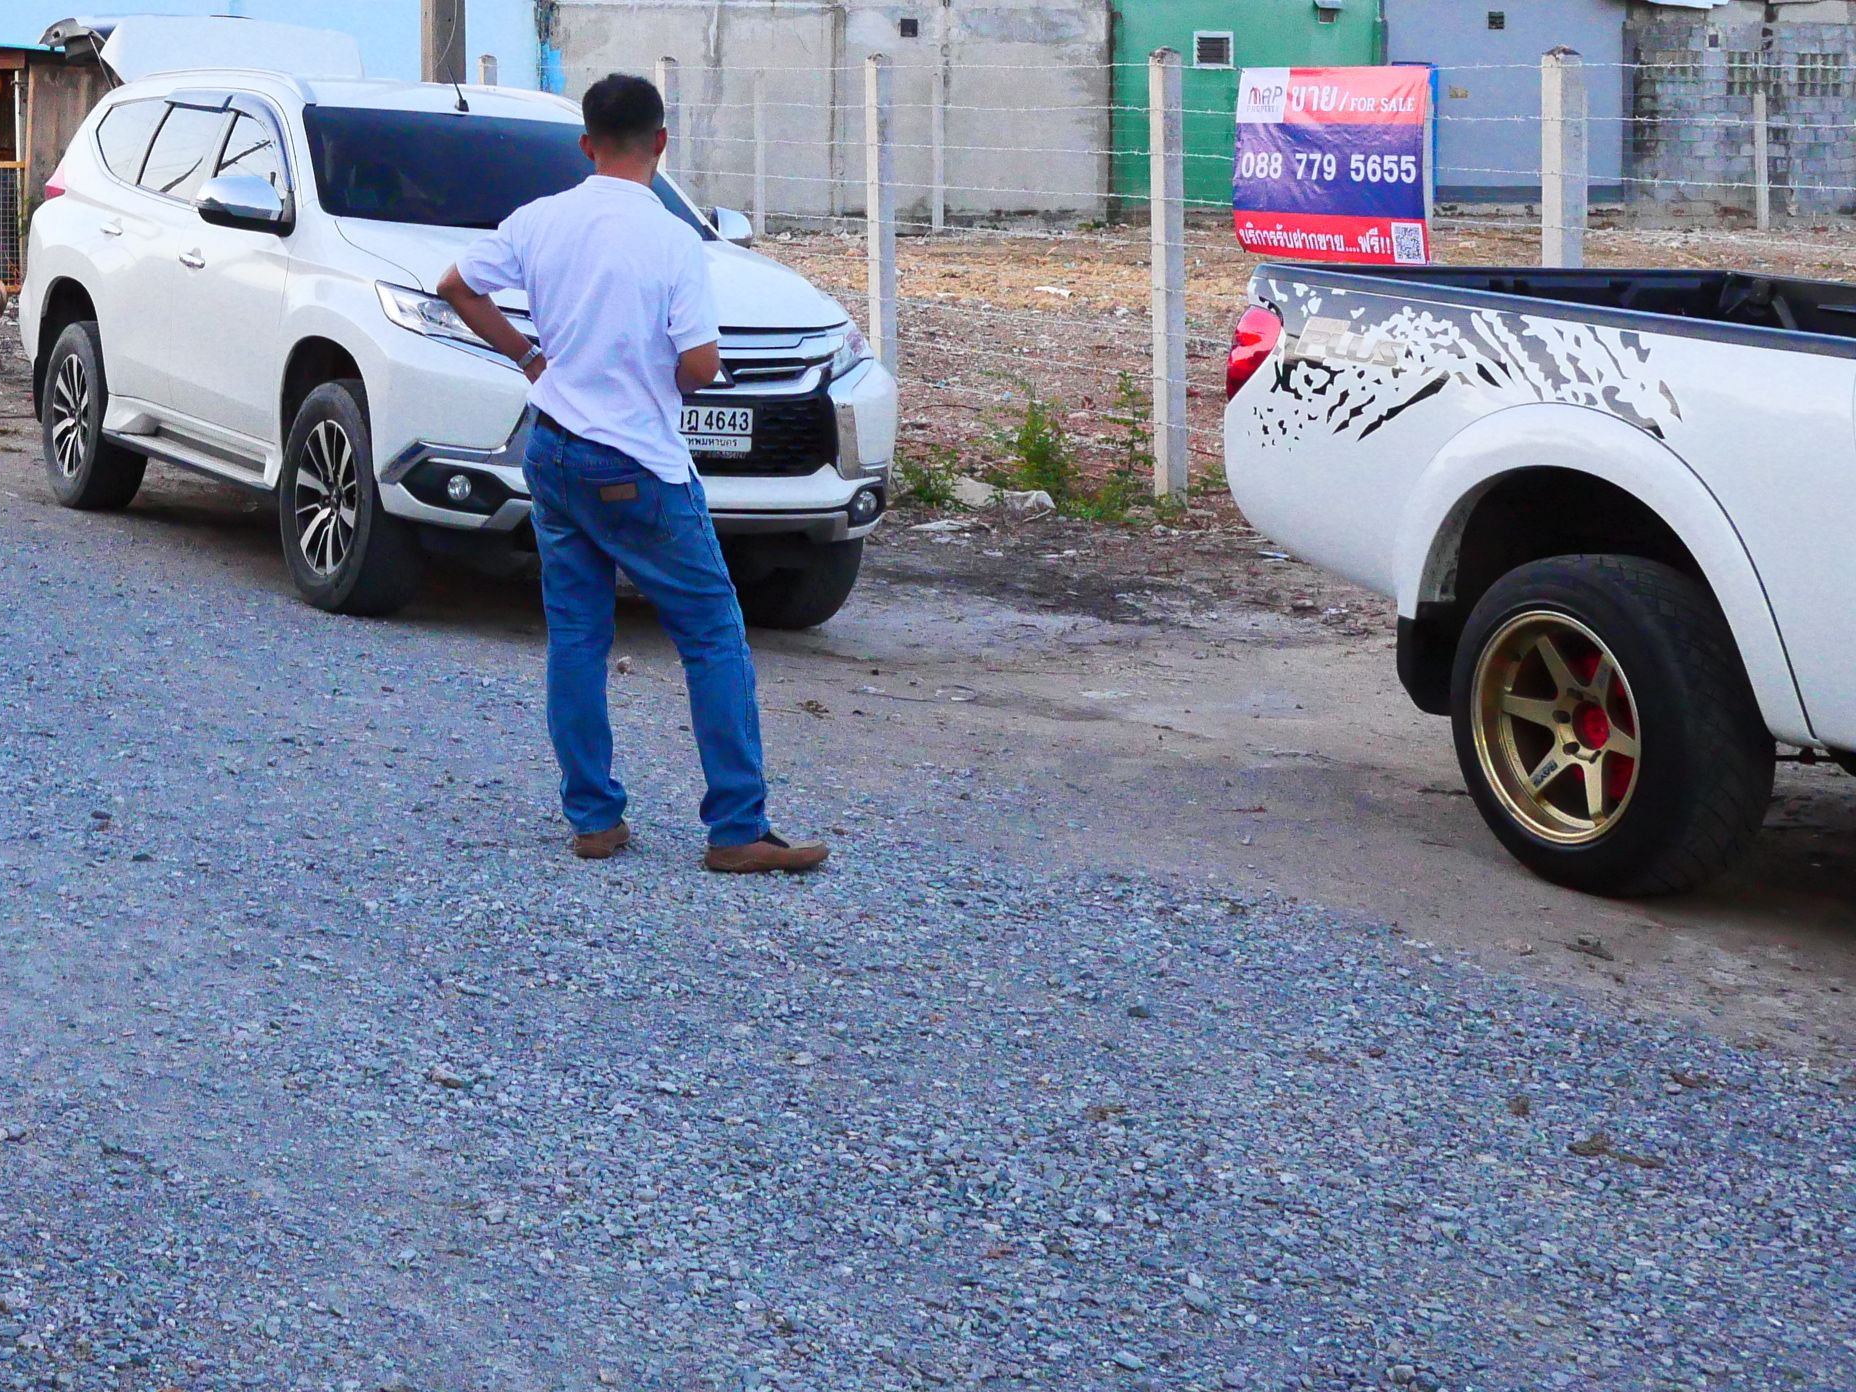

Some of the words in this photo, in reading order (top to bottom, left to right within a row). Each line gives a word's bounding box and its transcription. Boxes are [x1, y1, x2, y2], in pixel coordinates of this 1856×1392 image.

[1248, 85, 1283, 105] MAP
[1291, 85, 1339, 113] ขาย
[1349, 97, 1377, 112] FOR
[1380, 96, 1416, 112] SALE
[1241, 151, 1283, 180] 088
[1295, 153, 1337, 182] 779
[1350, 155, 1417, 185] 5655
[704, 409, 750, 432] 4643
